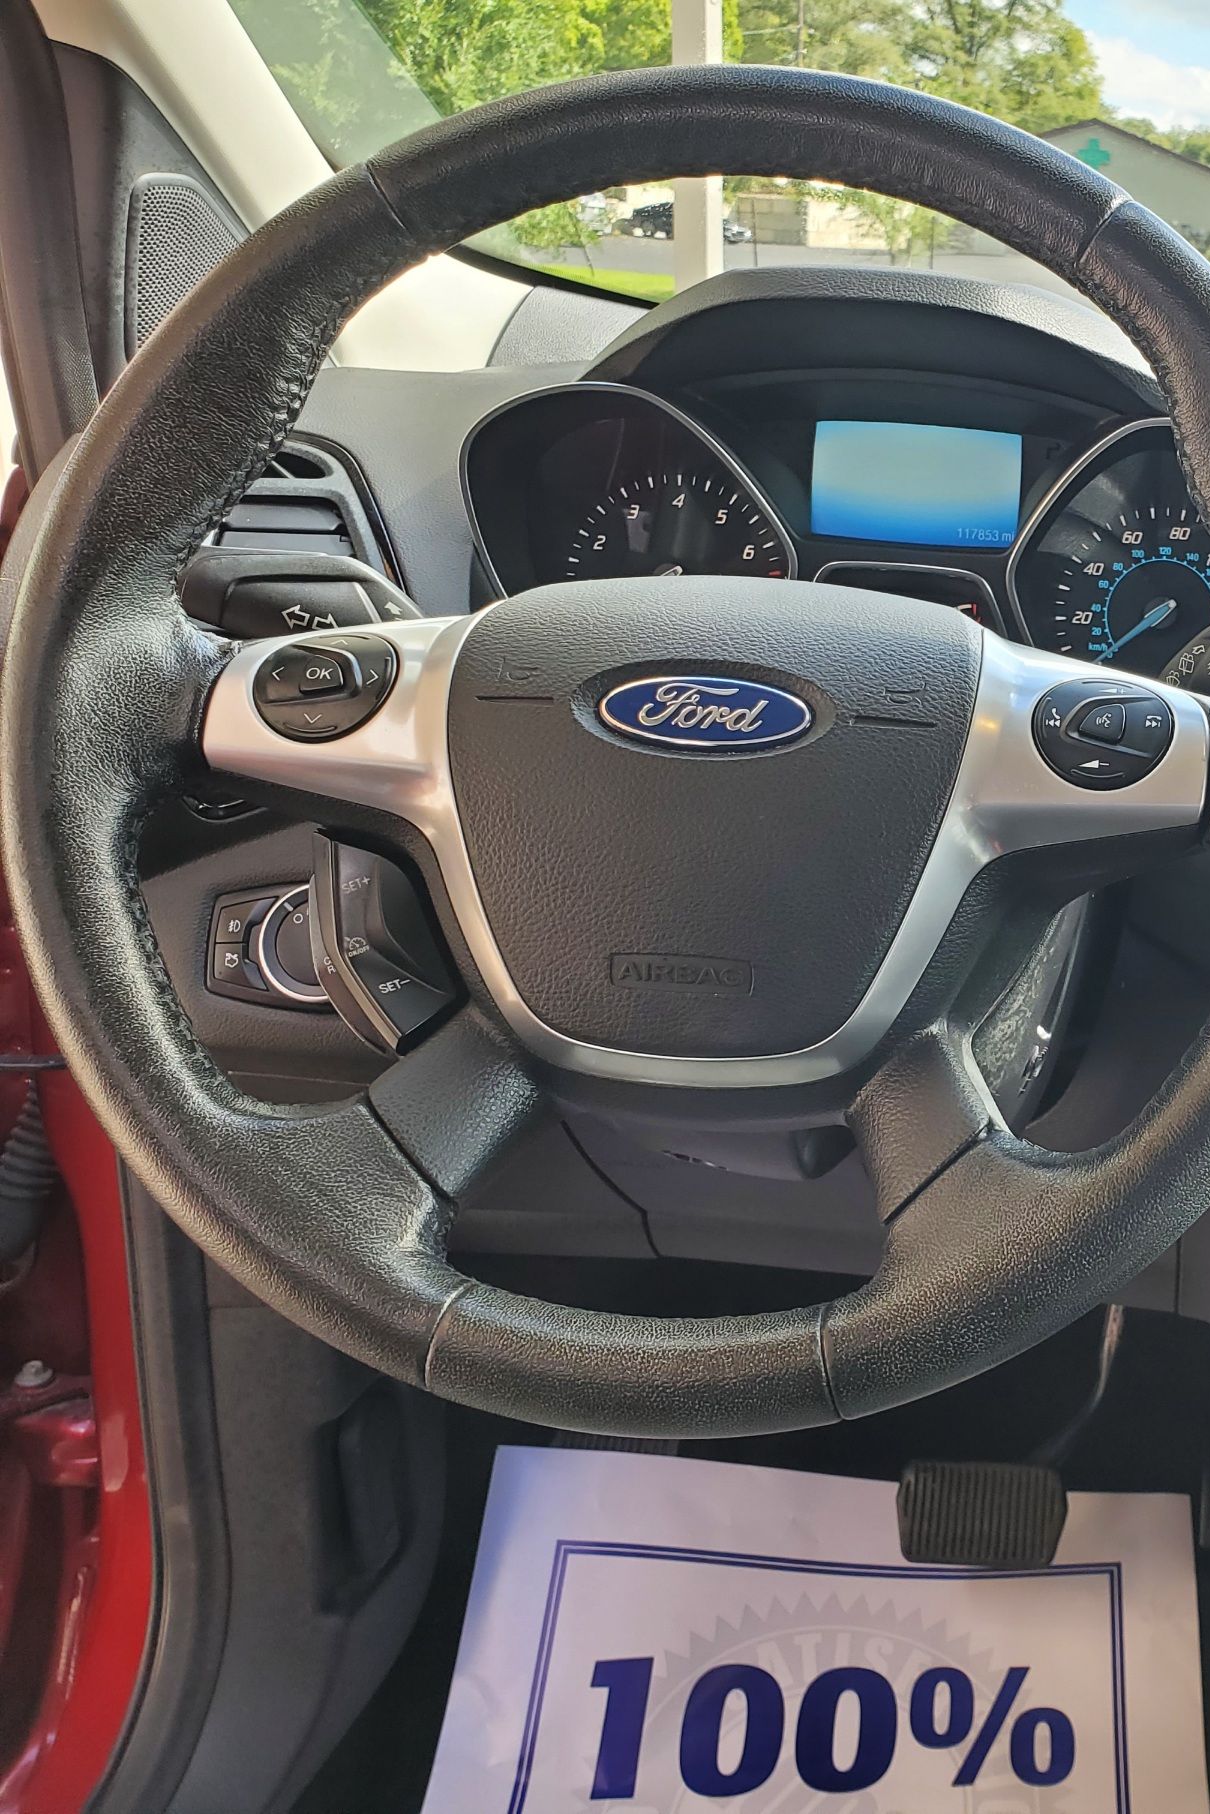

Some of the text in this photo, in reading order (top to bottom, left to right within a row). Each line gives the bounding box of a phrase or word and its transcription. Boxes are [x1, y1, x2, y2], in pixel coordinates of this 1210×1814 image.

[672, 493, 685, 508] 4
[627, 504, 640, 520] 3
[715, 509, 728, 525] 5
[956, 528, 1015, 542] 117853 mi
[1122, 531, 1143, 544] 60
[1169, 527, 1191, 540] 80
[593, 535, 607, 550] 2
[742, 545, 755, 560] 6
[1131, 549, 1145, 558] 100
[1159, 547, 1172, 556] 120
[1186, 553, 1199, 562] 140
[1083, 562, 1104, 576] 40
[1112, 562, 1123, 571] 80
[1098, 580, 1109, 588] 60
[1091, 604, 1101, 612] 40
[1072, 611, 1092, 624] 20
[1091, 626, 1102, 636] 20
[306, 667, 333, 680] OK
[637, 682, 769, 732] Ford
[348, 944, 370, 958] ON/OFF
[618, 960, 744, 987] AIRBAG
[590, 1656, 1076, 1800] 100%
